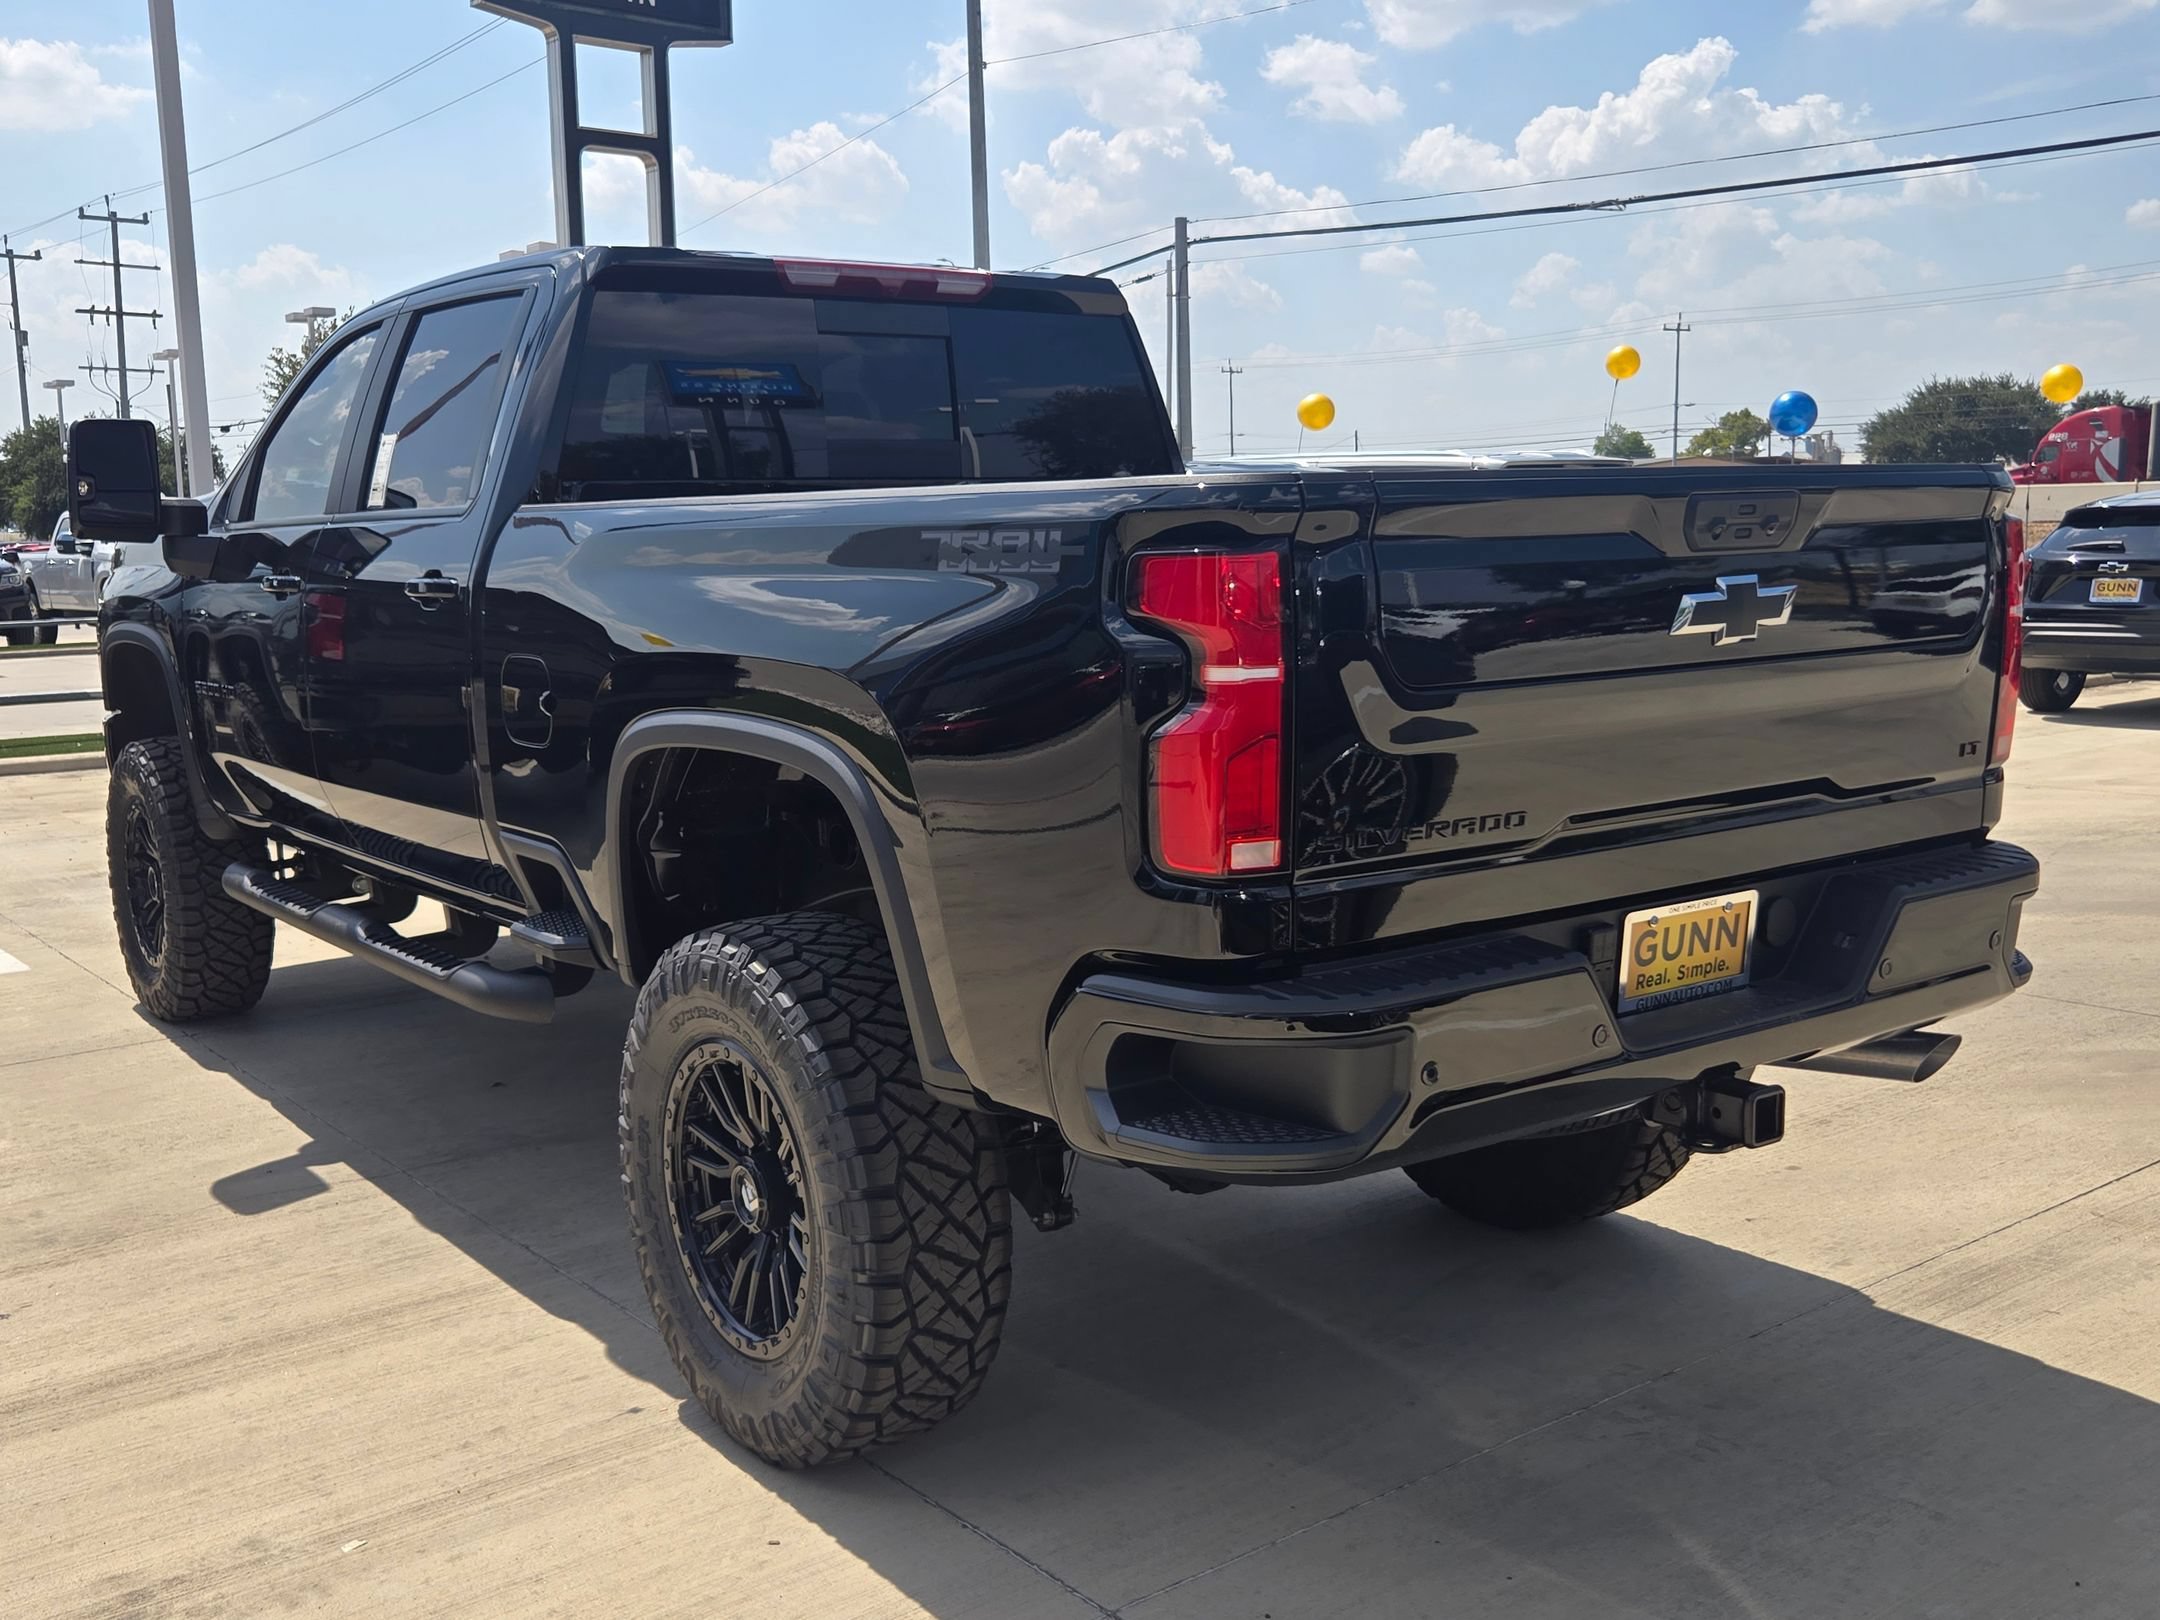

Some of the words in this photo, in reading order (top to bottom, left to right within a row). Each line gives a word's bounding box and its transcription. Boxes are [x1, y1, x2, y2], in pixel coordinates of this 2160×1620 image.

[2096, 582, 2138, 592] GUNN
[1316, 809, 1528, 853] SILVERADO
[1634, 913, 1741, 967] GUNN
[1635, 968, 1671, 990] Real.
[1636, 979, 1733, 1011] GUNNAUTO.COM
